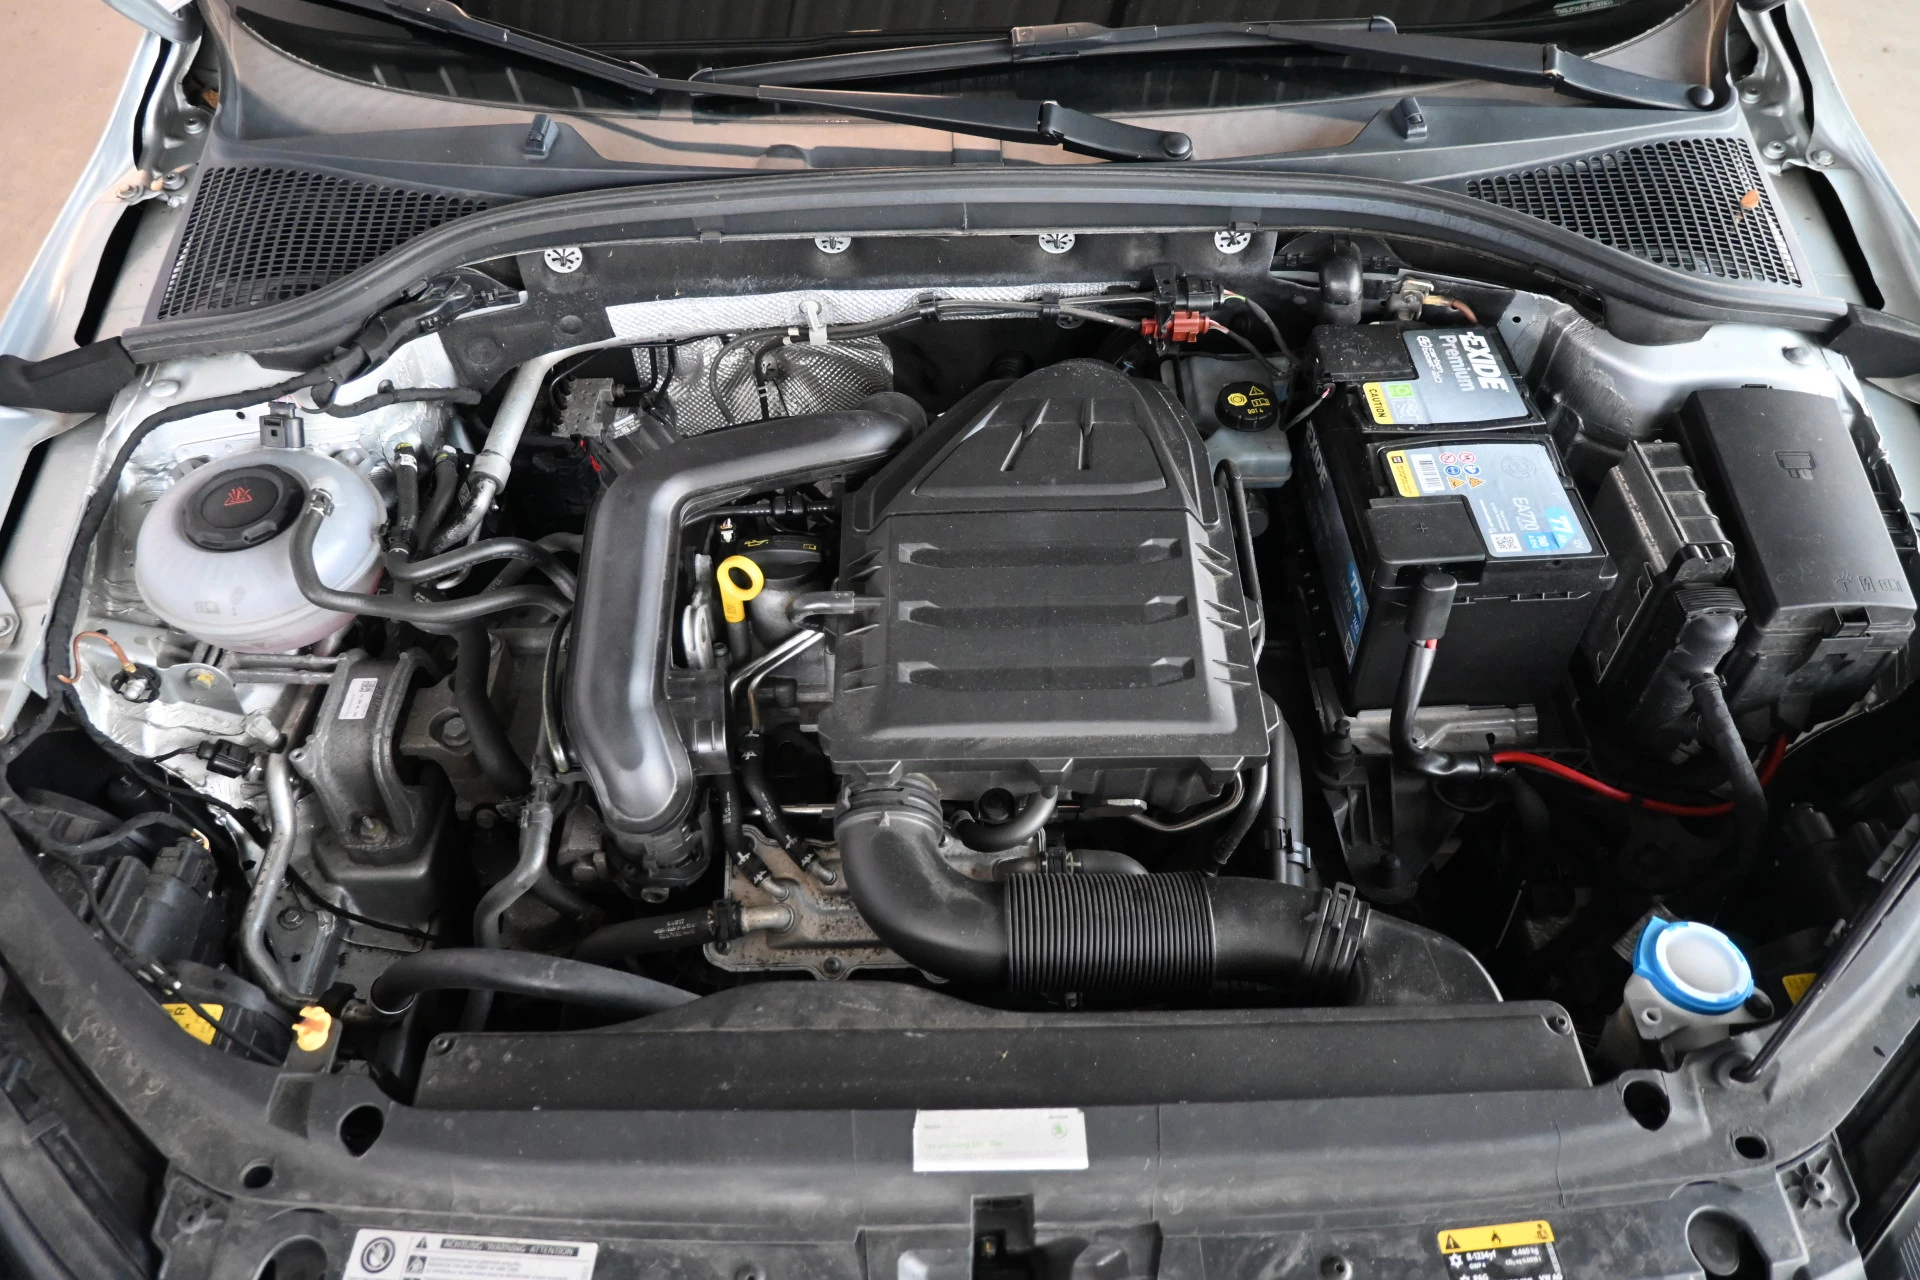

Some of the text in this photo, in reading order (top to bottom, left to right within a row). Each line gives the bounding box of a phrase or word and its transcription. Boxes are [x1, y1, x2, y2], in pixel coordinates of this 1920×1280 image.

[1438, 334, 1476, 392] Premium
[1458, 331, 1509, 390] EXIDE
[1368, 388, 1387, 418] CAUTION
[1305, 419, 1329, 491] EXIDE
[1511, 497, 1540, 531] EA770
[1549, 515, 1574, 533] 77
[1350, 570, 1361, 598] 77
[443, 1240, 574, 1256] ACHTUNG WARNING ATTENTION
